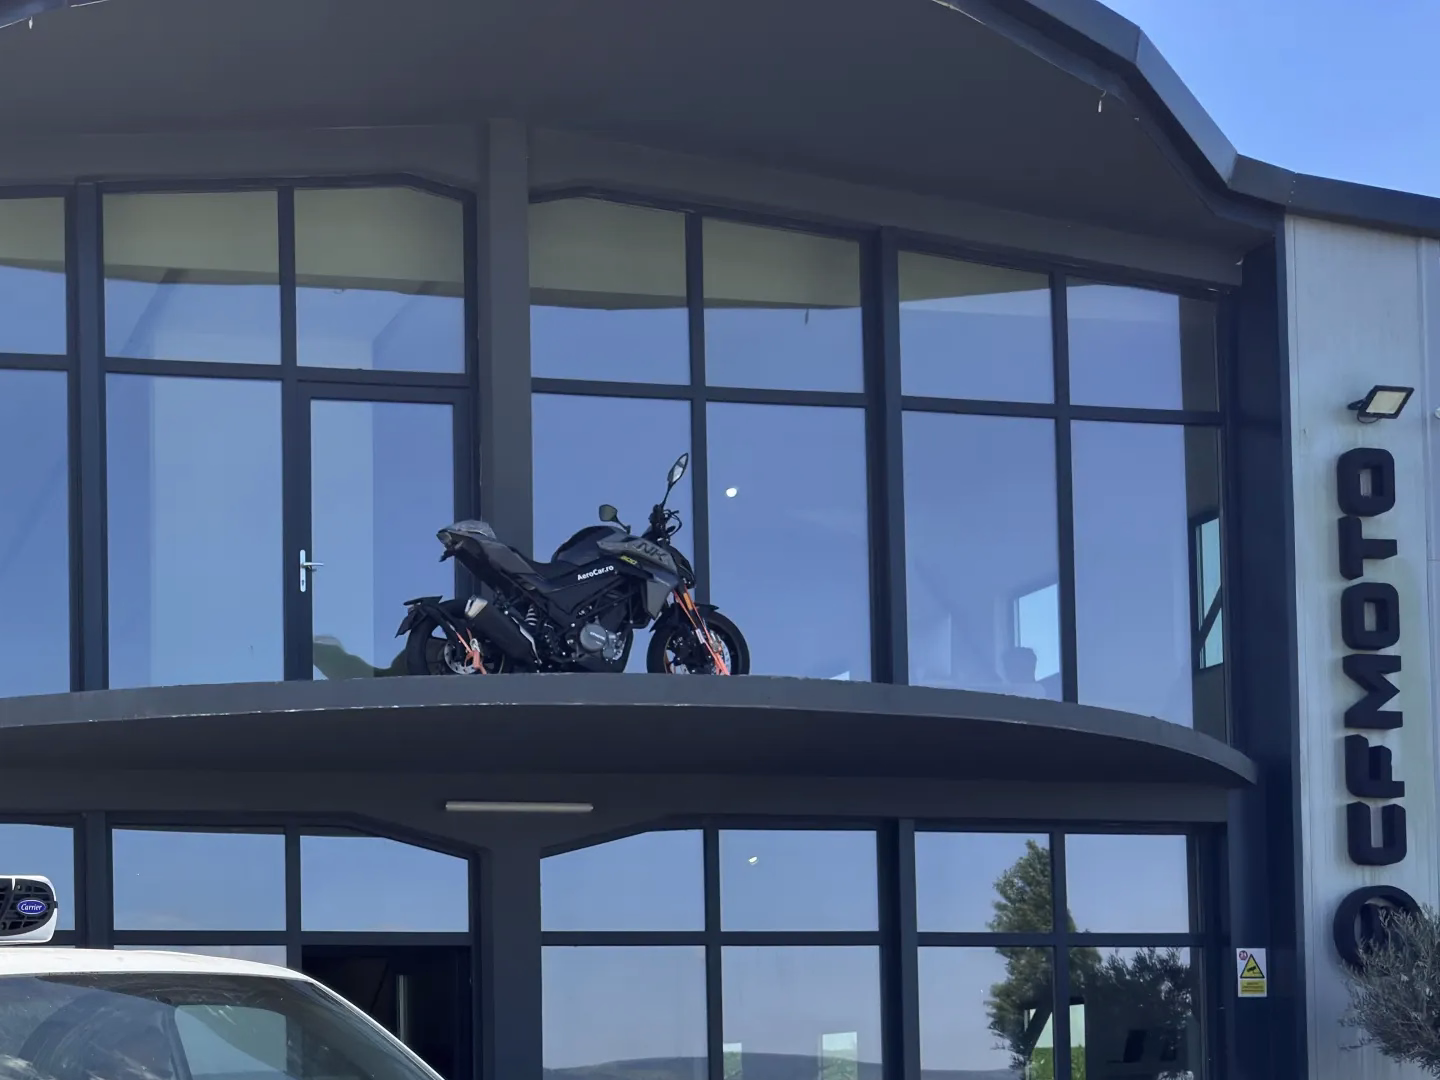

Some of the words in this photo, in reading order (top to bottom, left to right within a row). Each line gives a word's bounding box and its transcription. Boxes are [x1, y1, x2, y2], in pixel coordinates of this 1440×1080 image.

[577, 565, 615, 581] AeroCar.ro
[1336, 447, 1407, 866] CFMOTO
[20, 903, 43, 911] Carrier
